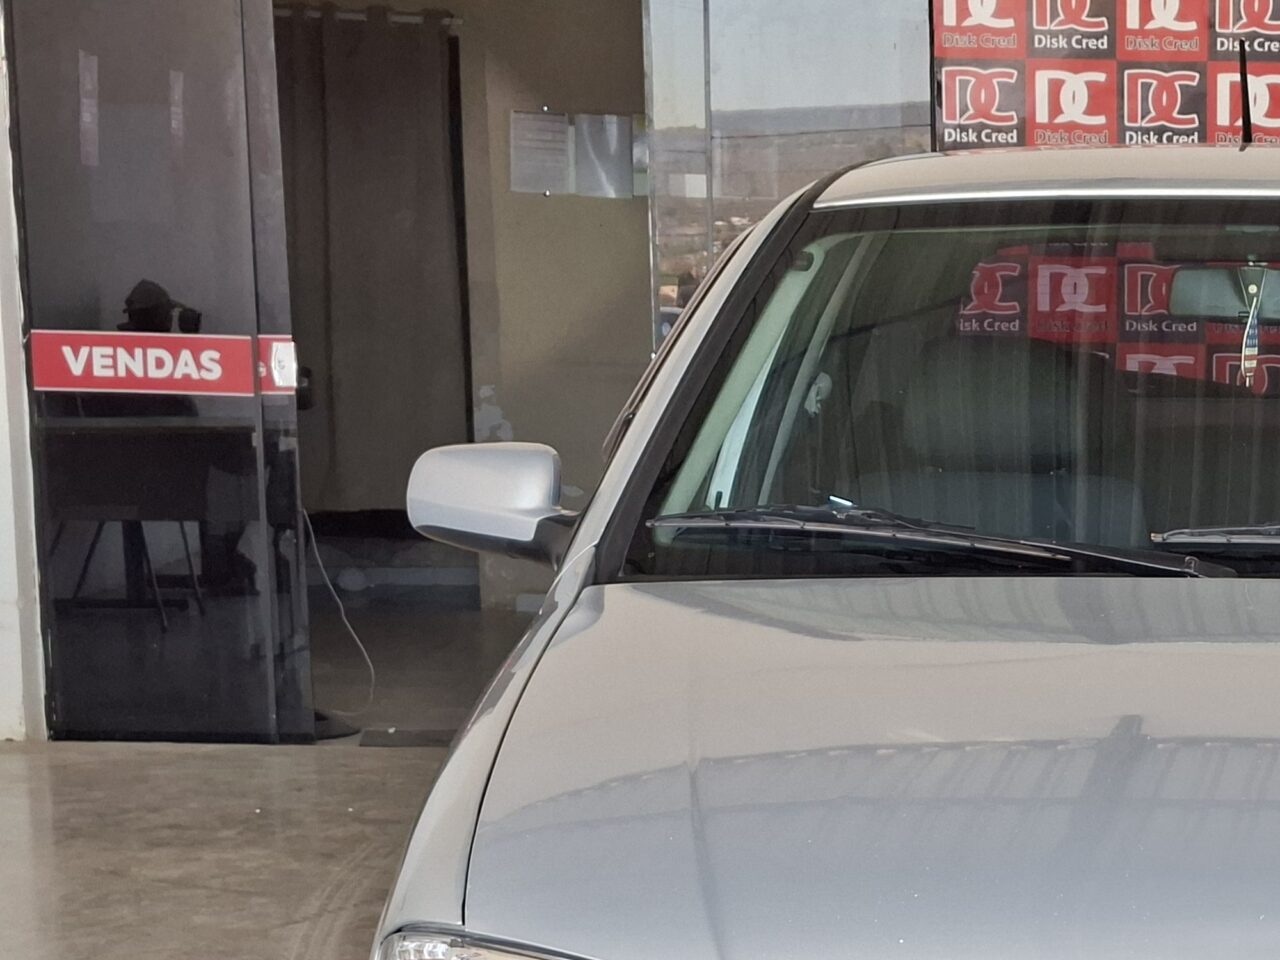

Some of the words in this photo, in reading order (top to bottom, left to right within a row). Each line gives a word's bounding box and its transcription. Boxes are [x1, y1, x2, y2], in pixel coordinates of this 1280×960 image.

[942, 33, 978, 48] Disk
[980, 33, 1017, 48] Cred
[1034, 34, 1068, 49] Disk
[1071, 35, 1108, 49] Cred
[1125, 35, 1160, 50] Disk
[1162, 36, 1200, 51] Cred
[944, 128, 977, 143] Disk
[981, 129, 1017, 143] Cred
[1034, 129, 1069, 145] Disk
[1071, 130, 1109, 145] Cred
[1126, 131, 1158, 144] Disk
[1162, 131, 1198, 144] Cred
[1216, 132, 1243, 144] Dis
[959, 318, 980, 331] isk
[984, 319, 1020, 331] Cred
[1125, 320, 1157, 332] Disk
[1162, 320, 1197, 332] Cred
[62, 345, 222, 381] VENDAS
